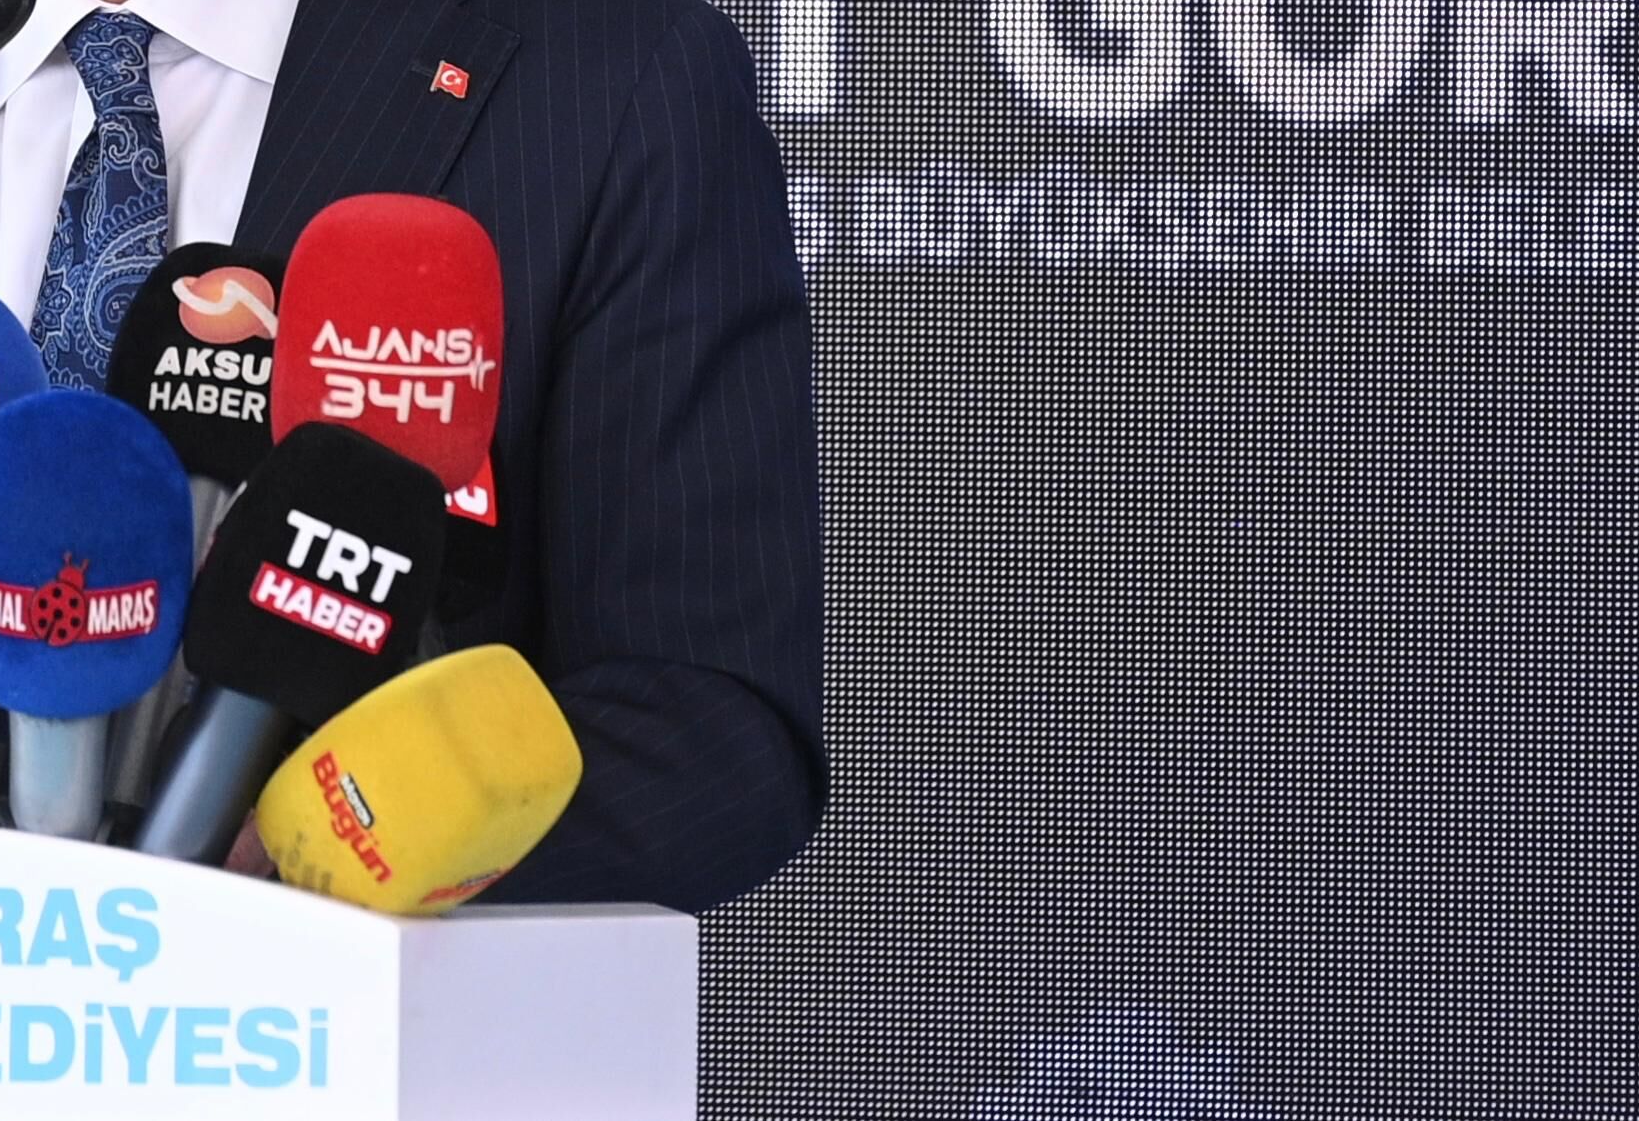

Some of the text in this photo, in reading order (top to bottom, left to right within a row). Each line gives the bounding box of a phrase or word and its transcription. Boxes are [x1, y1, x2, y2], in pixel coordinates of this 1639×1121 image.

[311, 319, 474, 365] AJANS
[155, 347, 272, 388] AKSU
[148, 381, 267, 424] HABER
[321, 373, 455, 424] 344
[286, 509, 412, 604] TRT
[87, 587, 155, 635] MARAŞ
[255, 569, 386, 650] HABER
